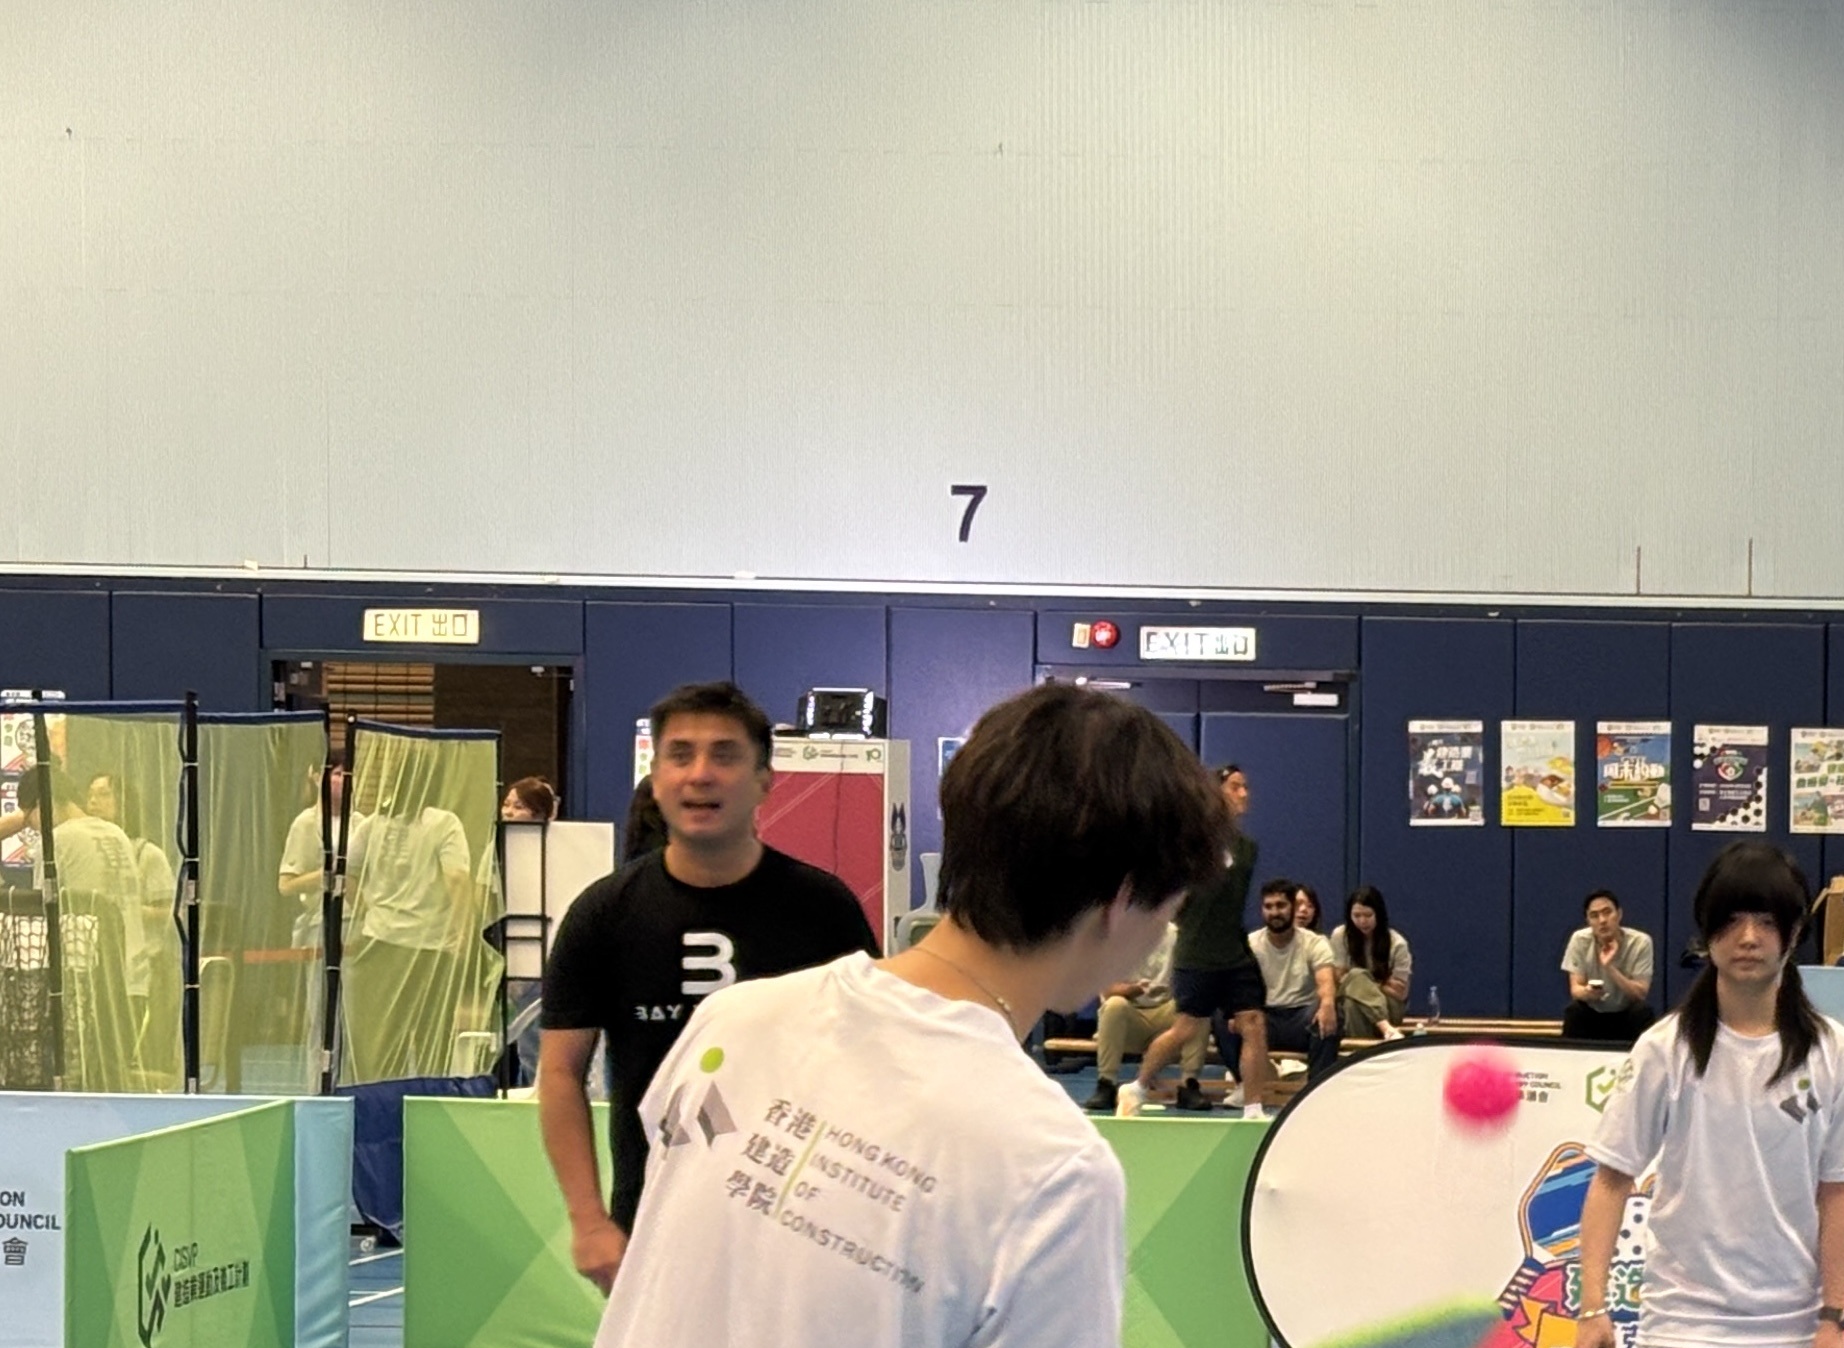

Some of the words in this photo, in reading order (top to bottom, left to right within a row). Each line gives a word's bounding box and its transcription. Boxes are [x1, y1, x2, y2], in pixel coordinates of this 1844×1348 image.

[951, 485, 987, 542] 7
[374, 613, 422, 637] EXIT
[432, 613, 469, 637] 出口
[1146, 631, 1209, 656] EXIT
[764, 1099, 817, 1140] 香港
[741, 1133, 796, 1176] 建造
[824, 1125, 881, 1162] HONG
[880, 1152, 937, 1193] KONG
[725, 1170, 778, 1216] 學院
[793, 1181, 820, 1201] OF
[808, 1153, 907, 1212] INSTITUTE
[2, 1236, 28, 1266] 會
[780, 1209, 926, 1294] CONSTRUCTION
